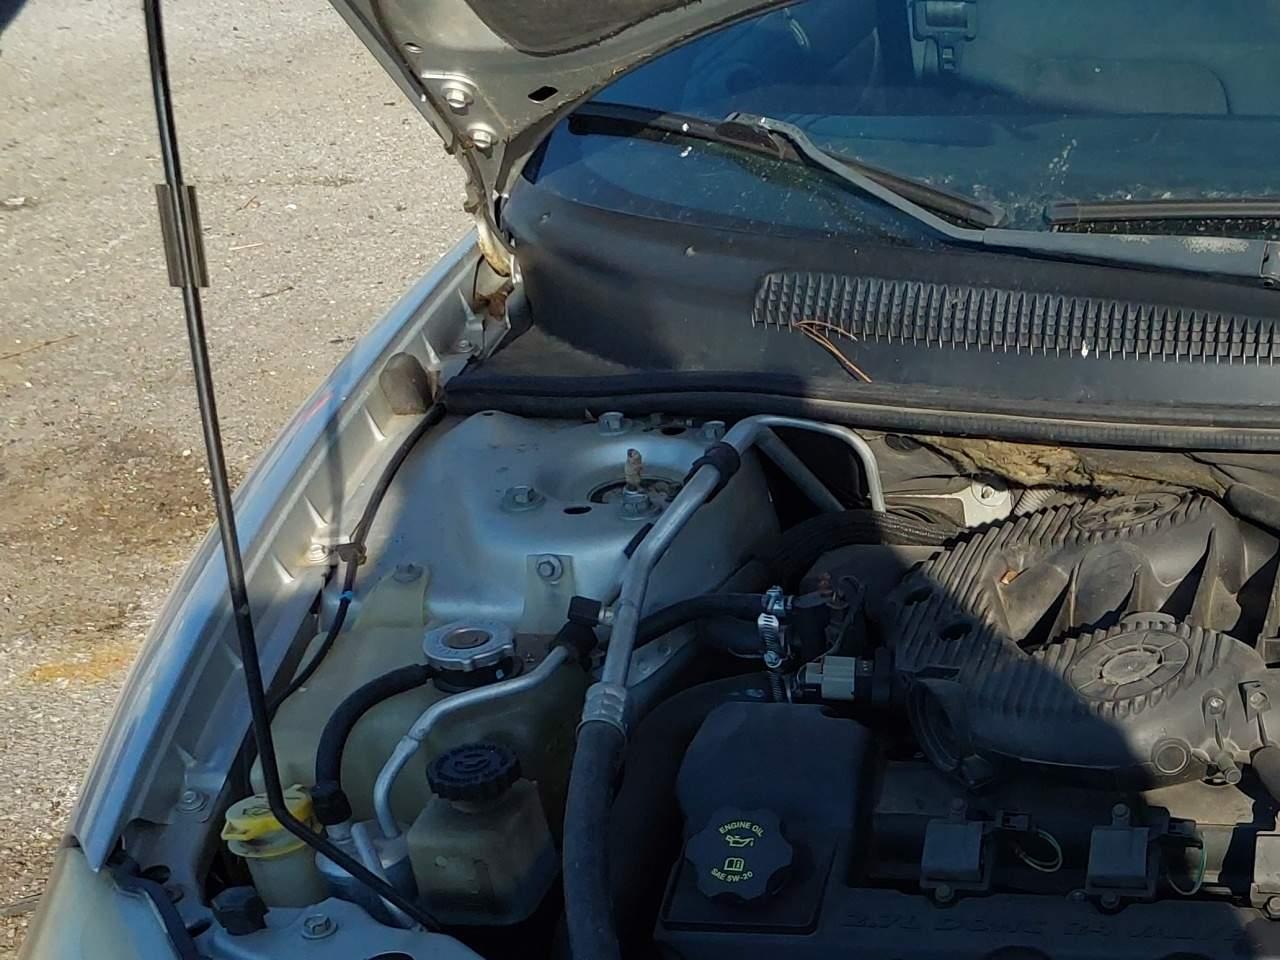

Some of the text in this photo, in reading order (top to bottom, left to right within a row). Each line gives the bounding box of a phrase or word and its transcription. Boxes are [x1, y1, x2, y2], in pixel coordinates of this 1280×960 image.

[719, 821, 763, 837] ENGINE OIL
[711, 868, 753, 882] SAE 5W-20
